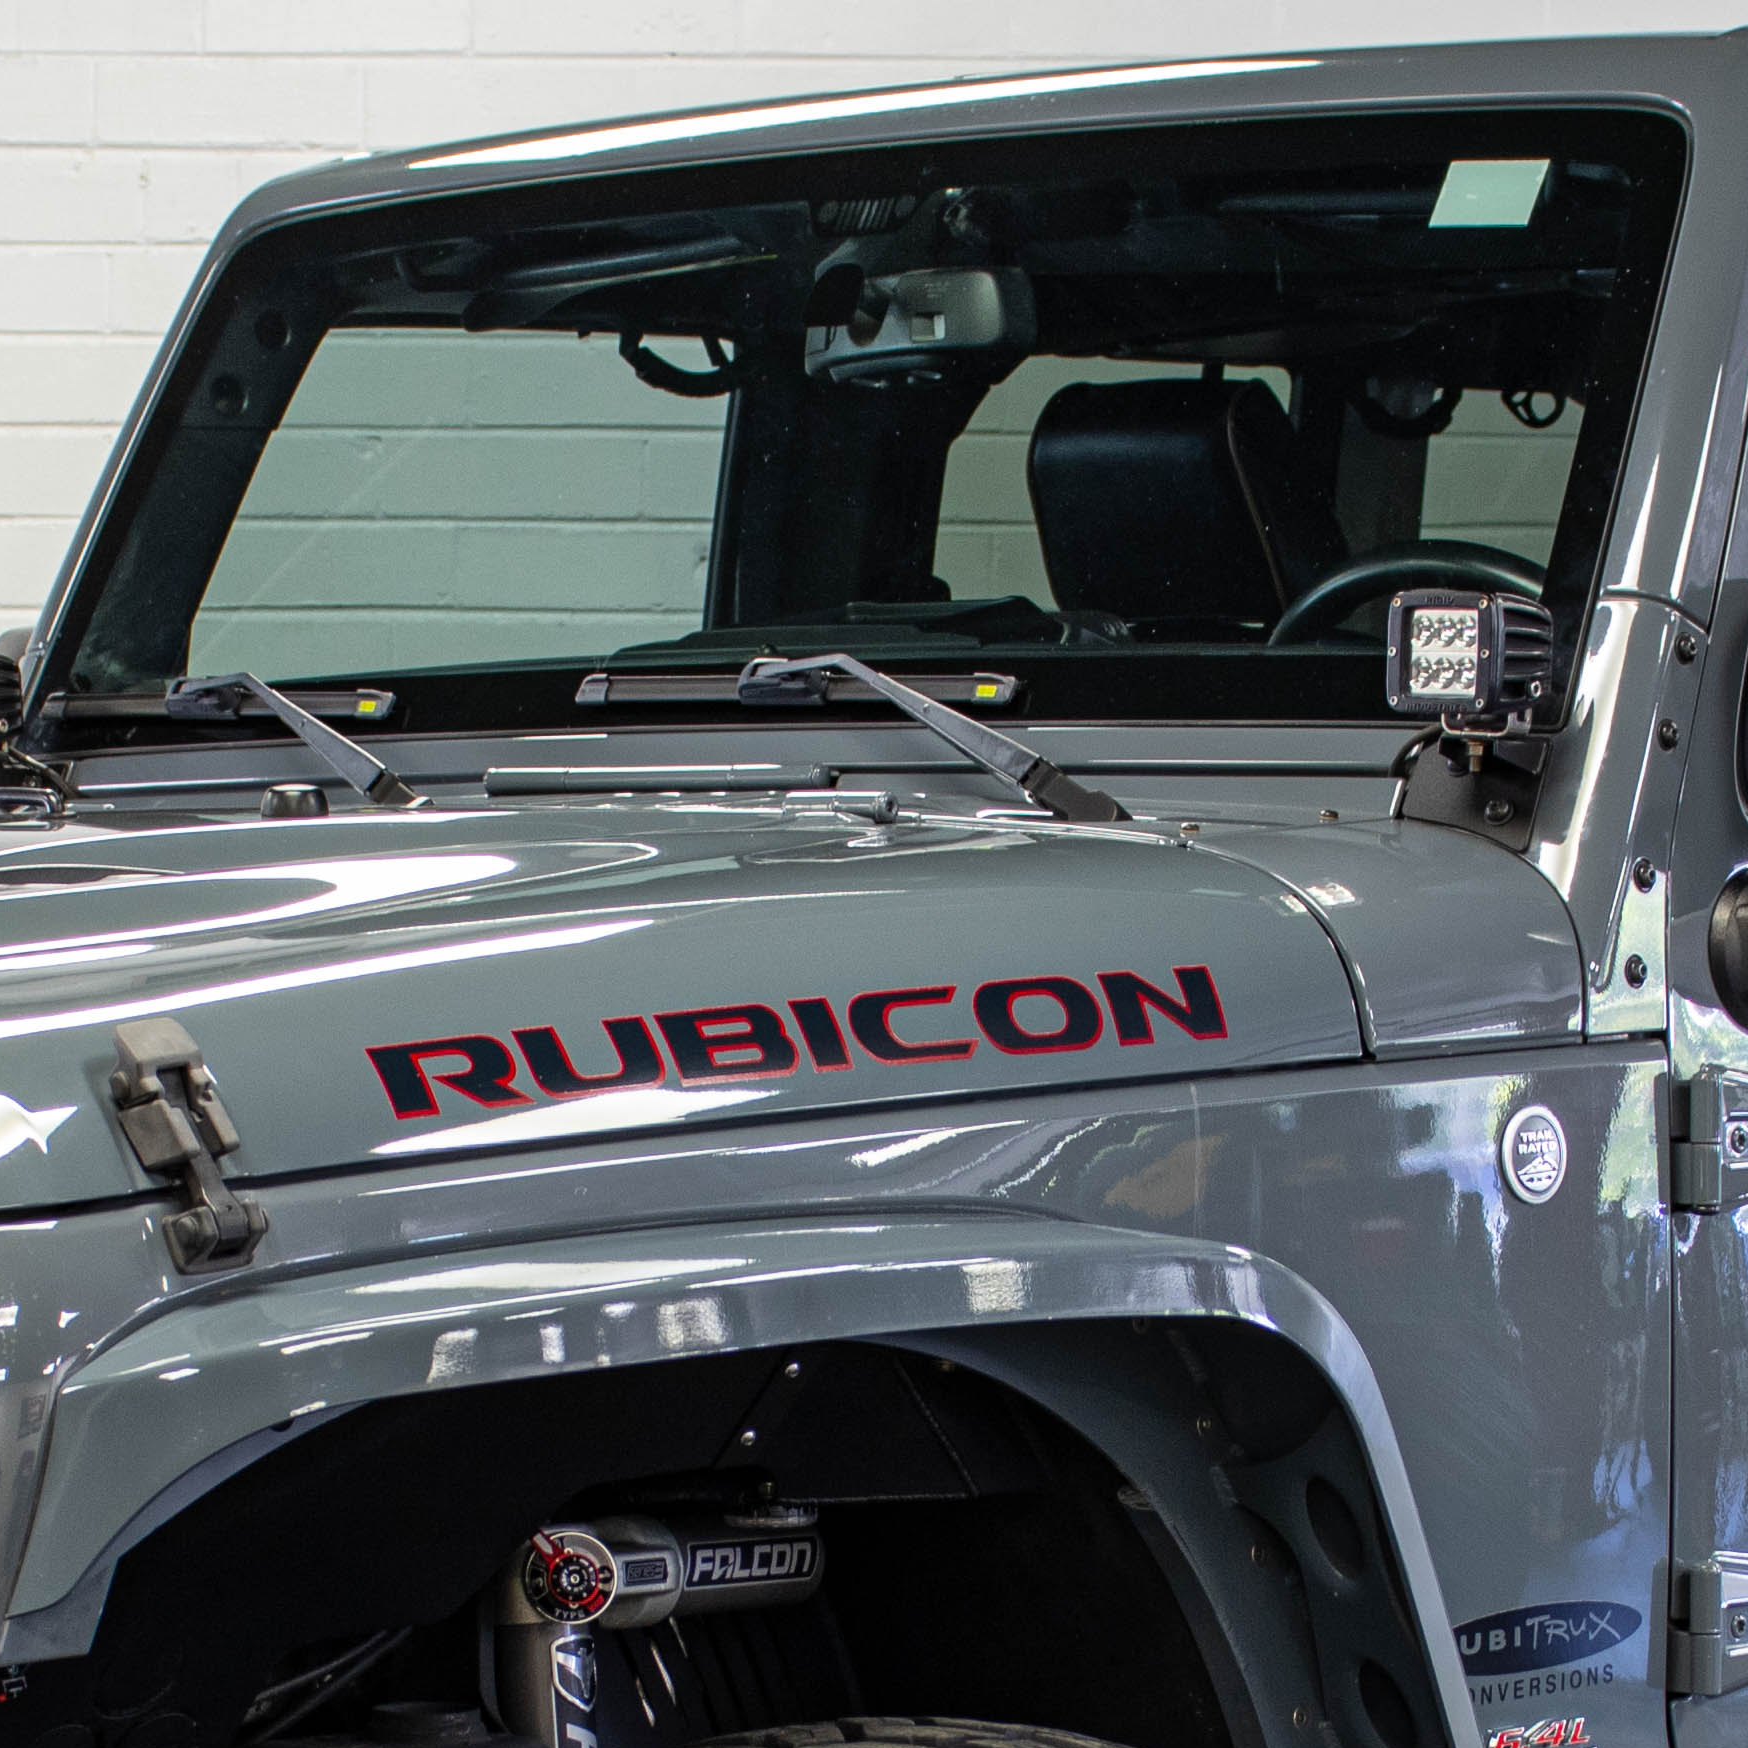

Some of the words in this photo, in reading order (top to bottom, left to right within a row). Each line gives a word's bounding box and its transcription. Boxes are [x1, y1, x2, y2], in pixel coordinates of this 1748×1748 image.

[366, 965, 1230, 1120] RUBICON
[1518, 1141, 1558, 1155] RATED
[692, 1541, 812, 1582] FALCON
[1458, 1609, 1621, 1655] UBITRUX
